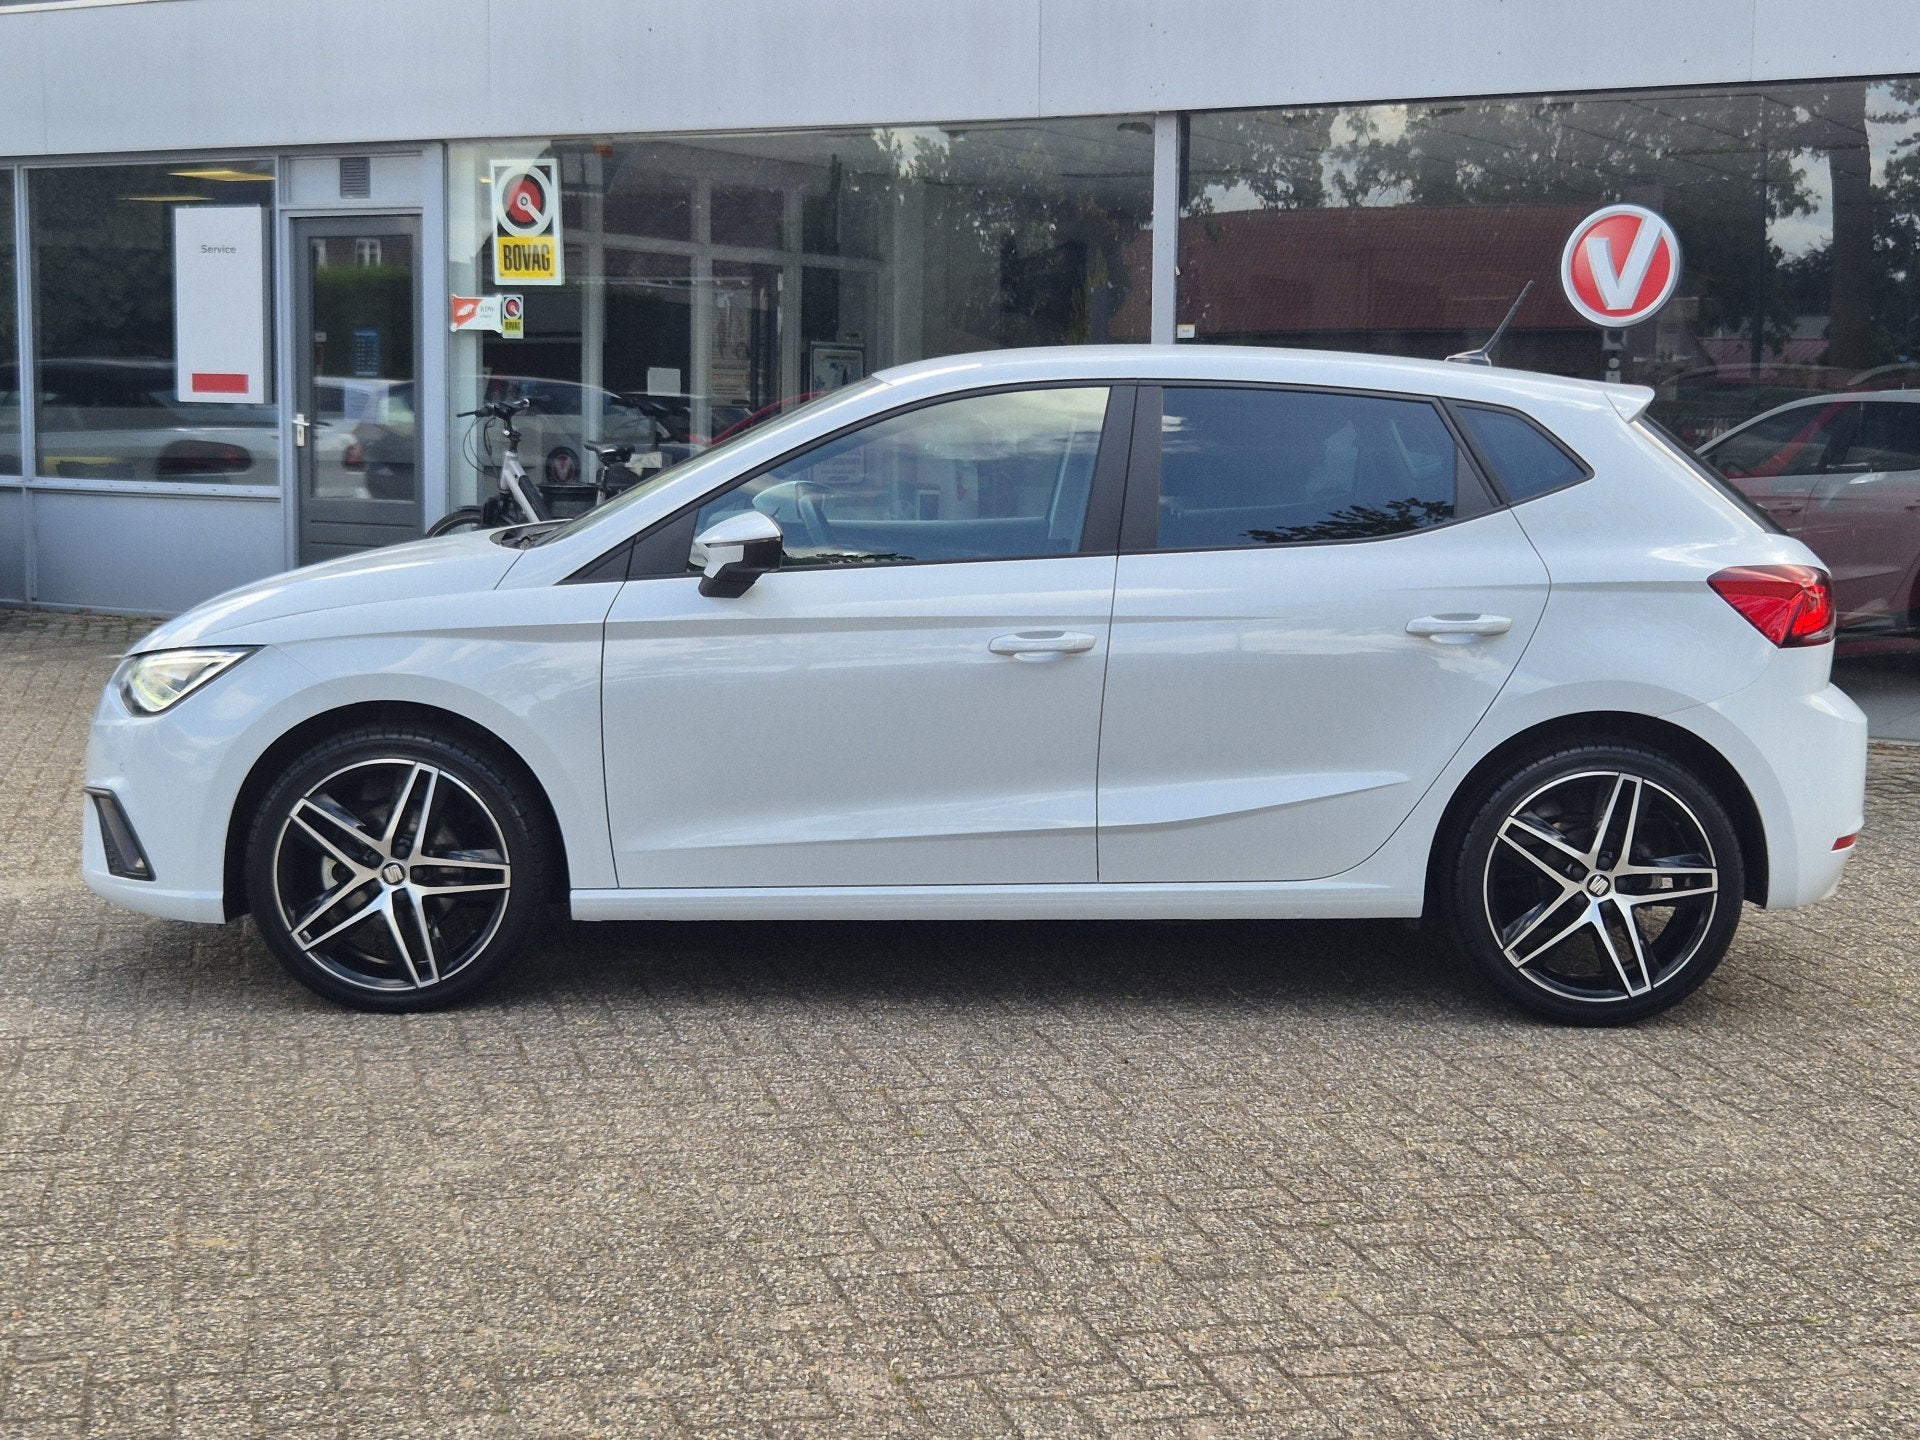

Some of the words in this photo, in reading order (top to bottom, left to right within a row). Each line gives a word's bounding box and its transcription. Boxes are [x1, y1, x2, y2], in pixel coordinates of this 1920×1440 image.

[201, 244, 236, 254] Service
[503, 244, 550, 272] BOVAG
[1585, 208, 1663, 310] V
